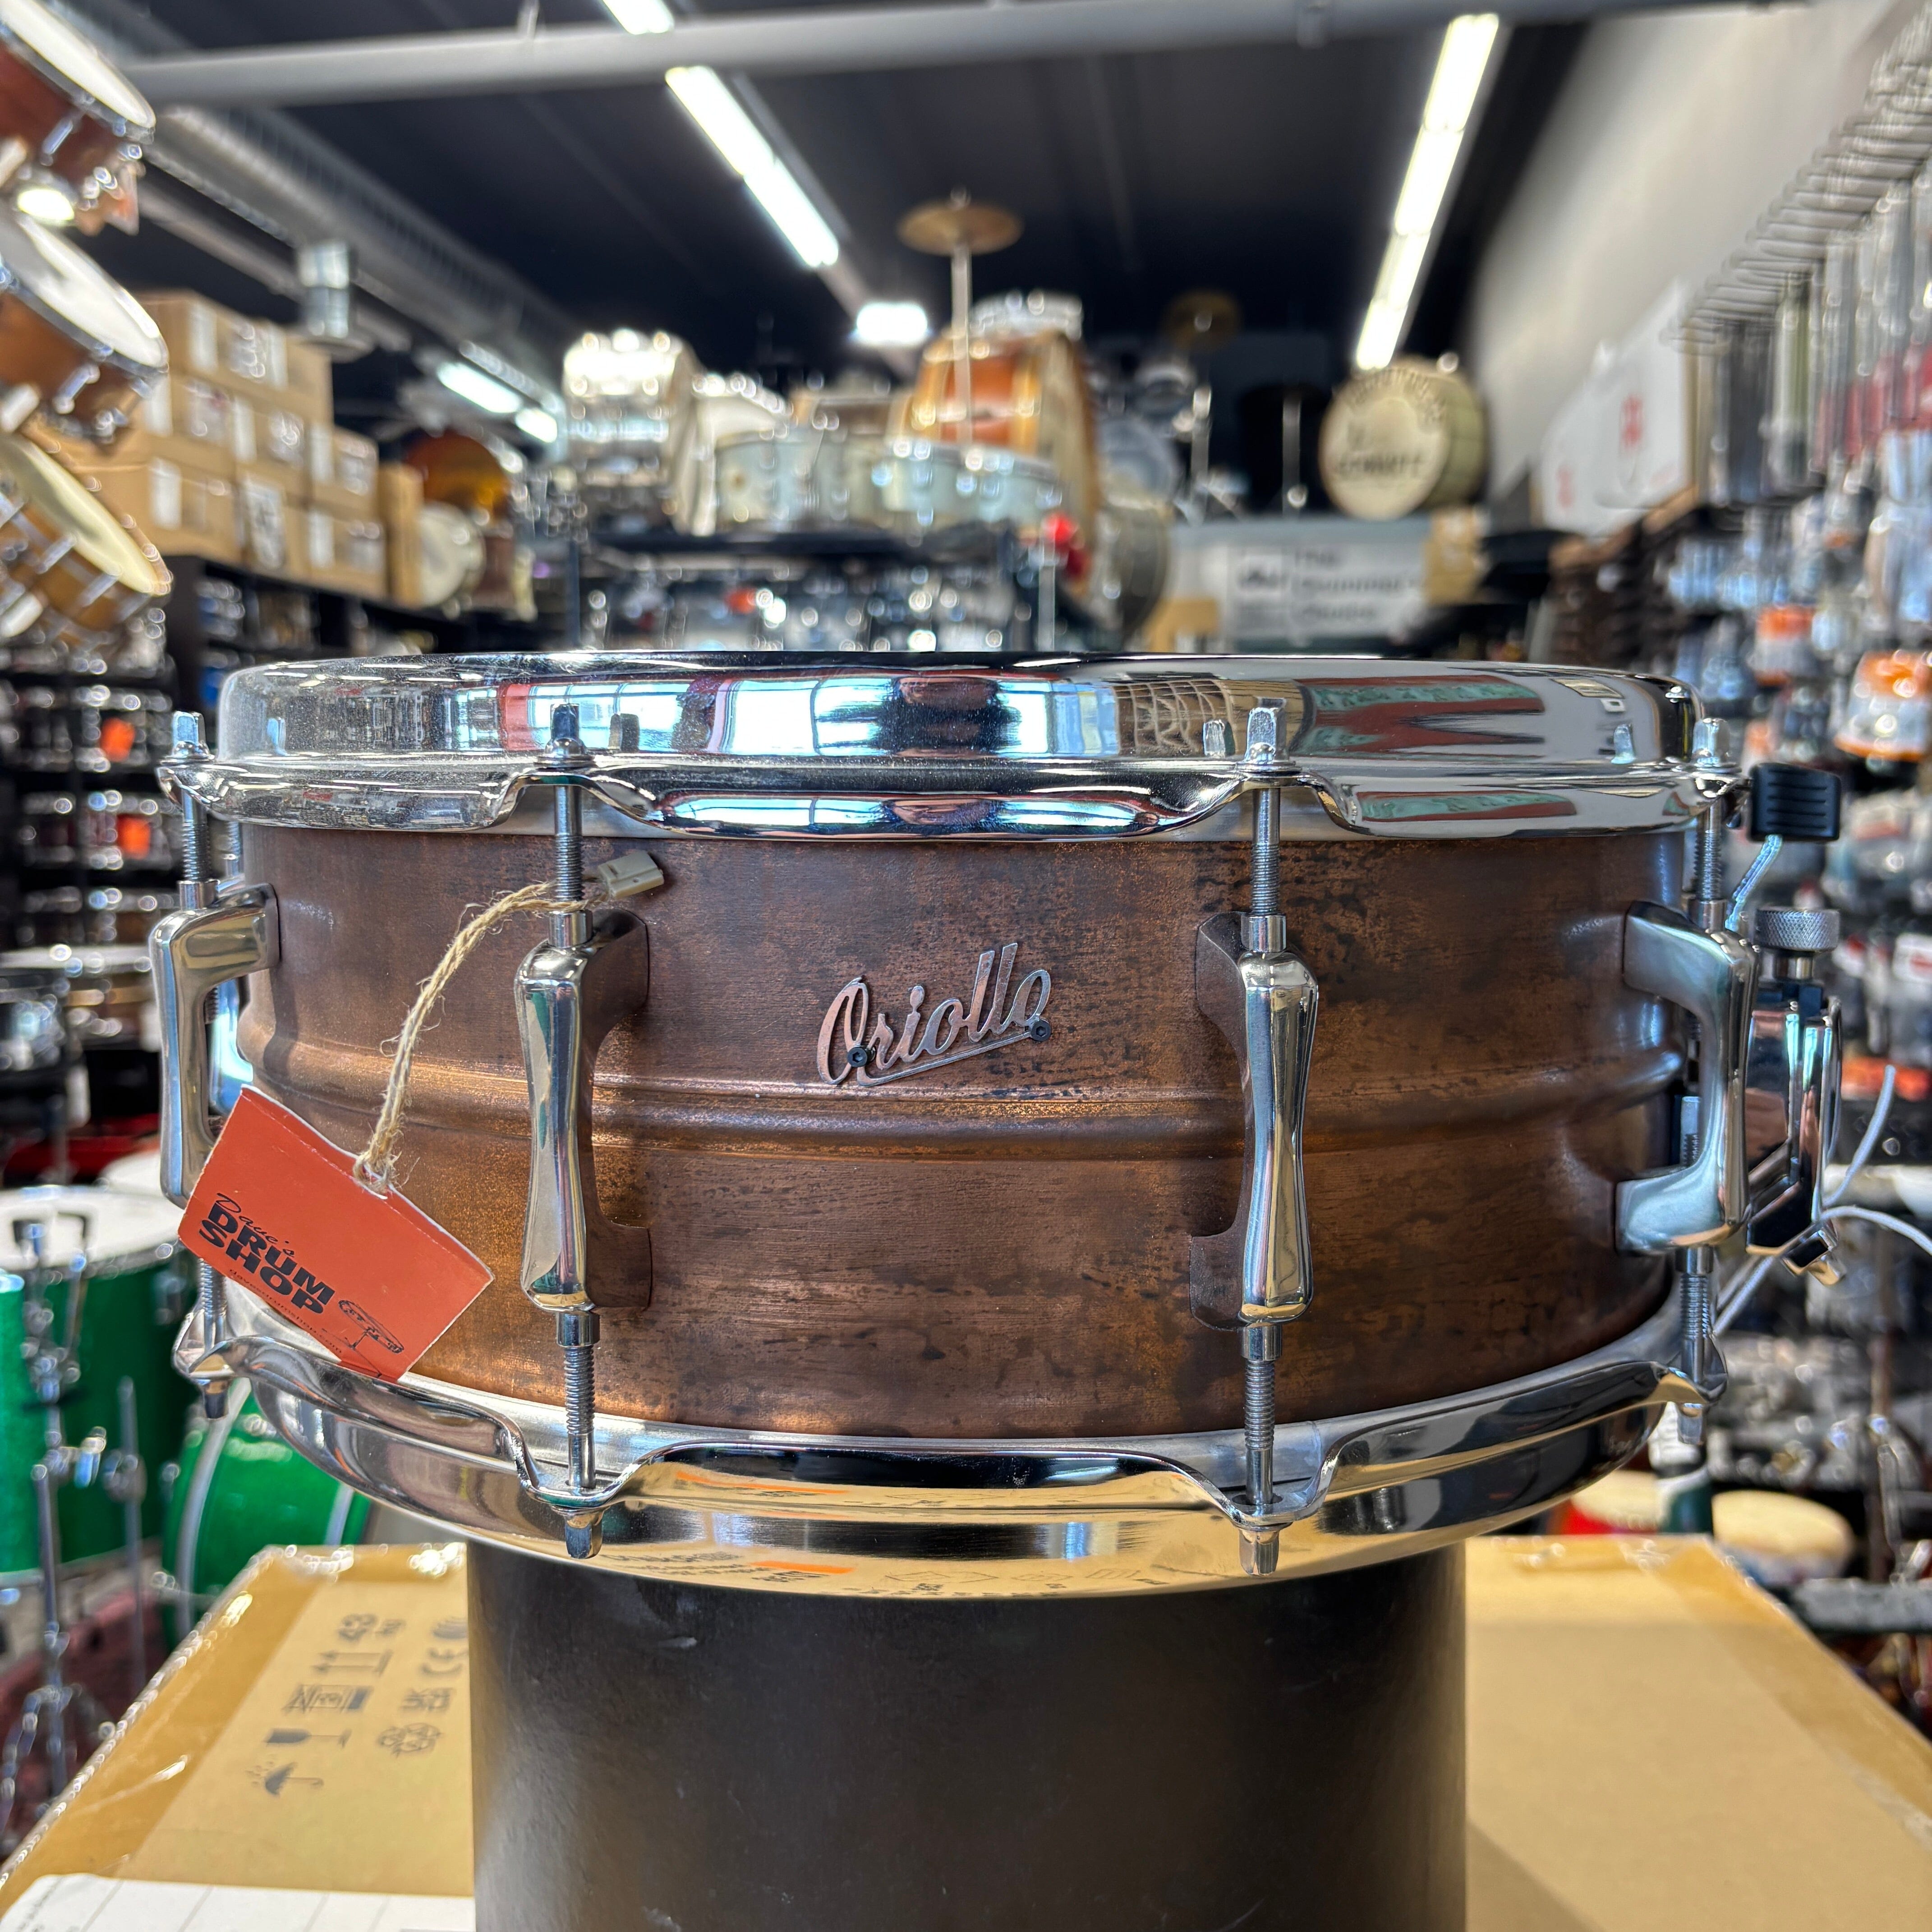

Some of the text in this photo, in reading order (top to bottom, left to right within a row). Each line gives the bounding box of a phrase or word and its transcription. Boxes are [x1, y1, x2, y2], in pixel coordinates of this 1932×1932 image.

[817, 942, 1051, 1086] Oriollo
[199, 1219, 324, 1314] SHOP
[208, 1203, 335, 1306] DRUM
[216, 1193, 295, 1256] Dave's
[229, 1268, 343, 1354] davesdrumshop.com
